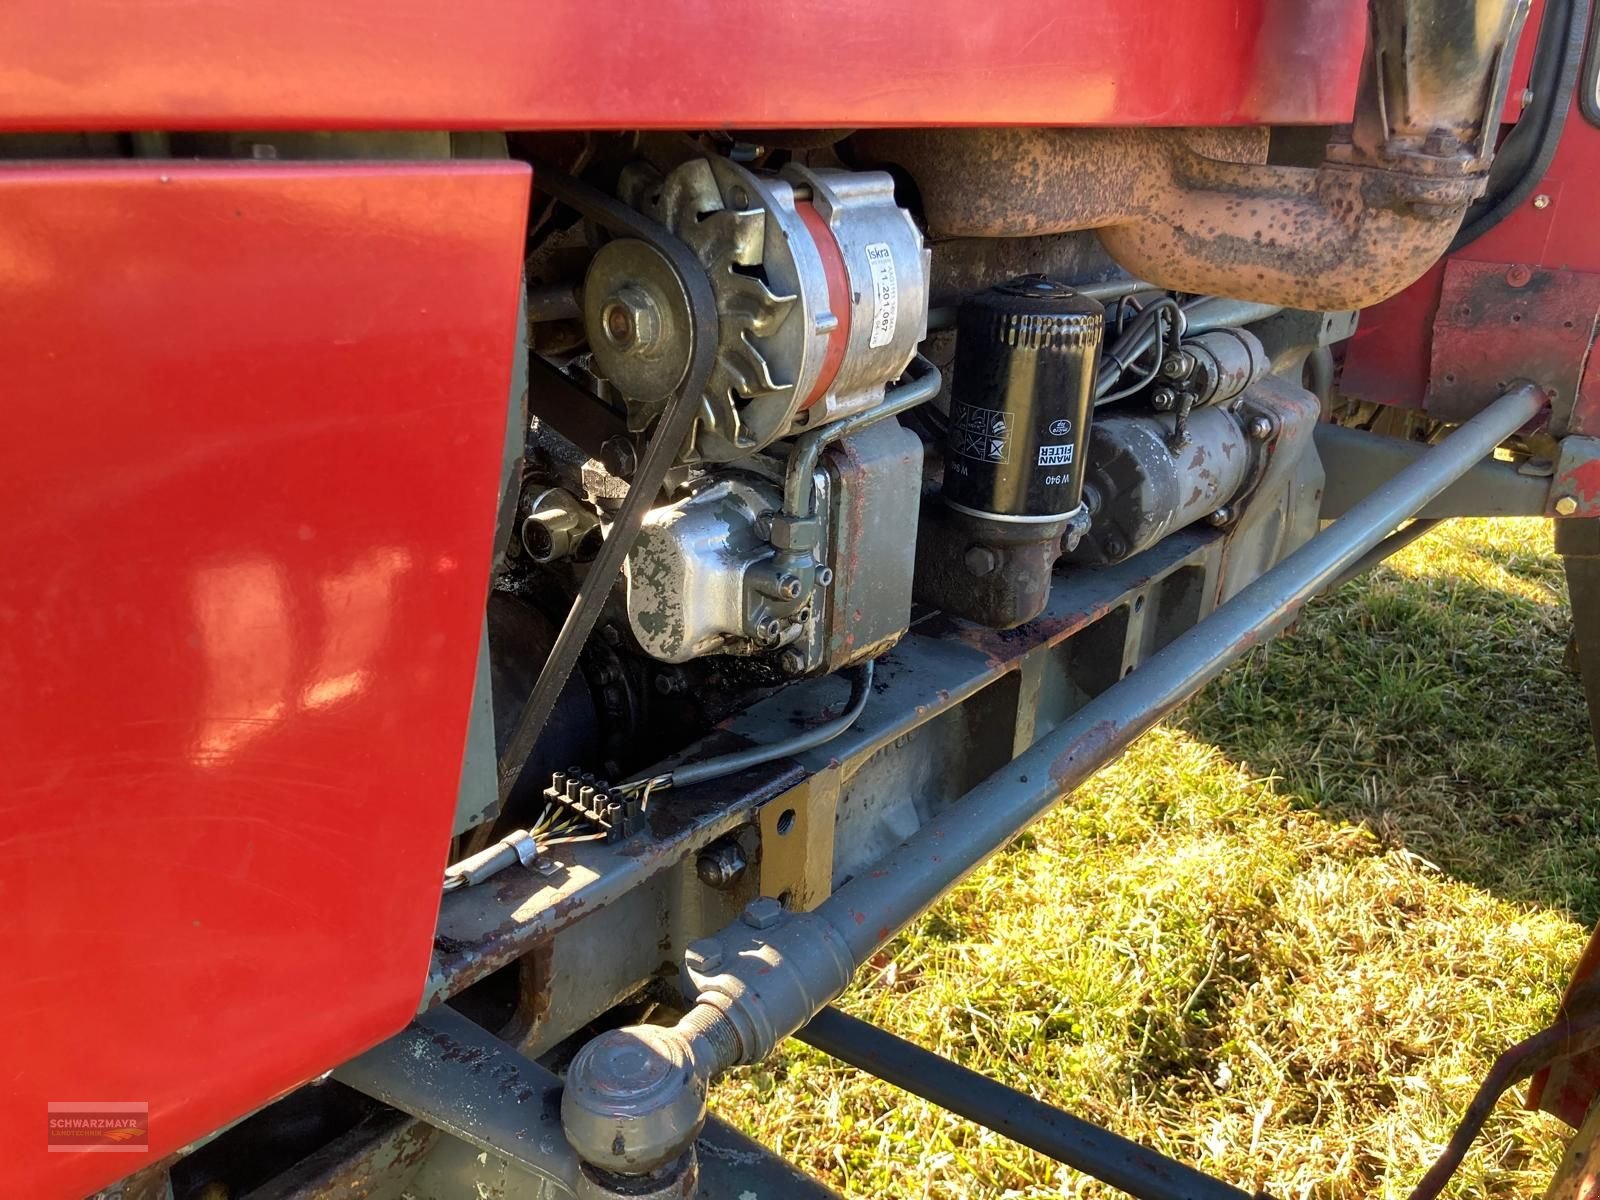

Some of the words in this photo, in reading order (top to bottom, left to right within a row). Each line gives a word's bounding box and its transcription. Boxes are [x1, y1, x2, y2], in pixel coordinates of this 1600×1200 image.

[867, 247, 890, 260] Iskra
[1041, 446, 1072, 456] FILTER
[1040, 455, 1071, 464] MANN
[1045, 475, 1061, 485] 940
[1061, 474, 1070, 484] W
